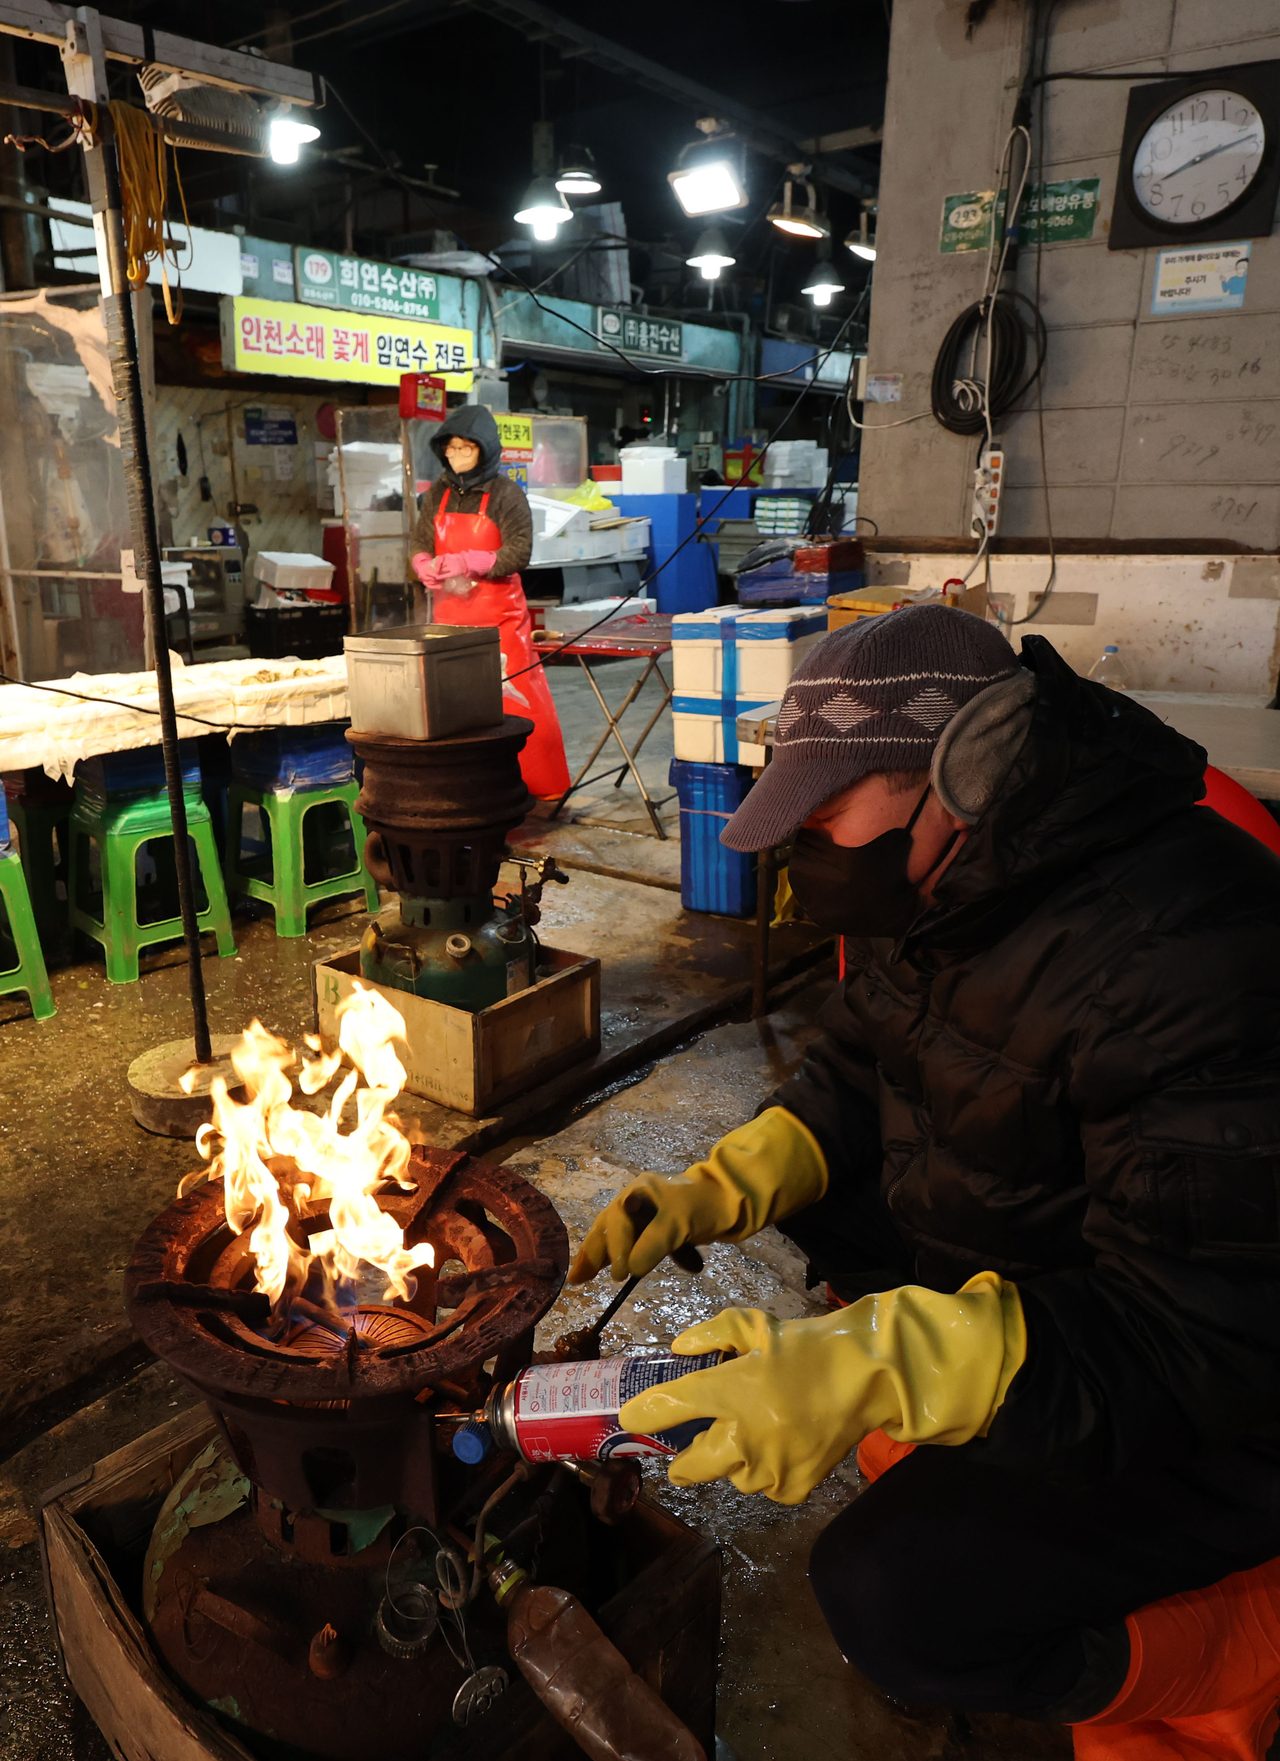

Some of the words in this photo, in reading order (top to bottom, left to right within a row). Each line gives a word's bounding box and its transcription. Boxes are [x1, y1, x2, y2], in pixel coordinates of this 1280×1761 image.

[1190, 101, 1209, 126] 12
[1220, 99, 1227, 121] 1
[1235, 109, 1249, 132] 2
[1171, 112, 1184, 136] 11
[1150, 137, 1172, 162] 10
[1139, 164, 1153, 186] 9
[1235, 164, 1247, 185] 4
[1149, 183, 1163, 206] 8
[1191, 194, 1205, 216] 6
[1217, 183, 1229, 204] 5
[1171, 194, 1184, 217] 7
[308, 260, 328, 277] 179
[241, 317, 325, 360] 인천소래
[333, 327, 369, 363] 꽃게
[377, 335, 428, 371] 임연수
[435, 342, 466, 374] 전문
